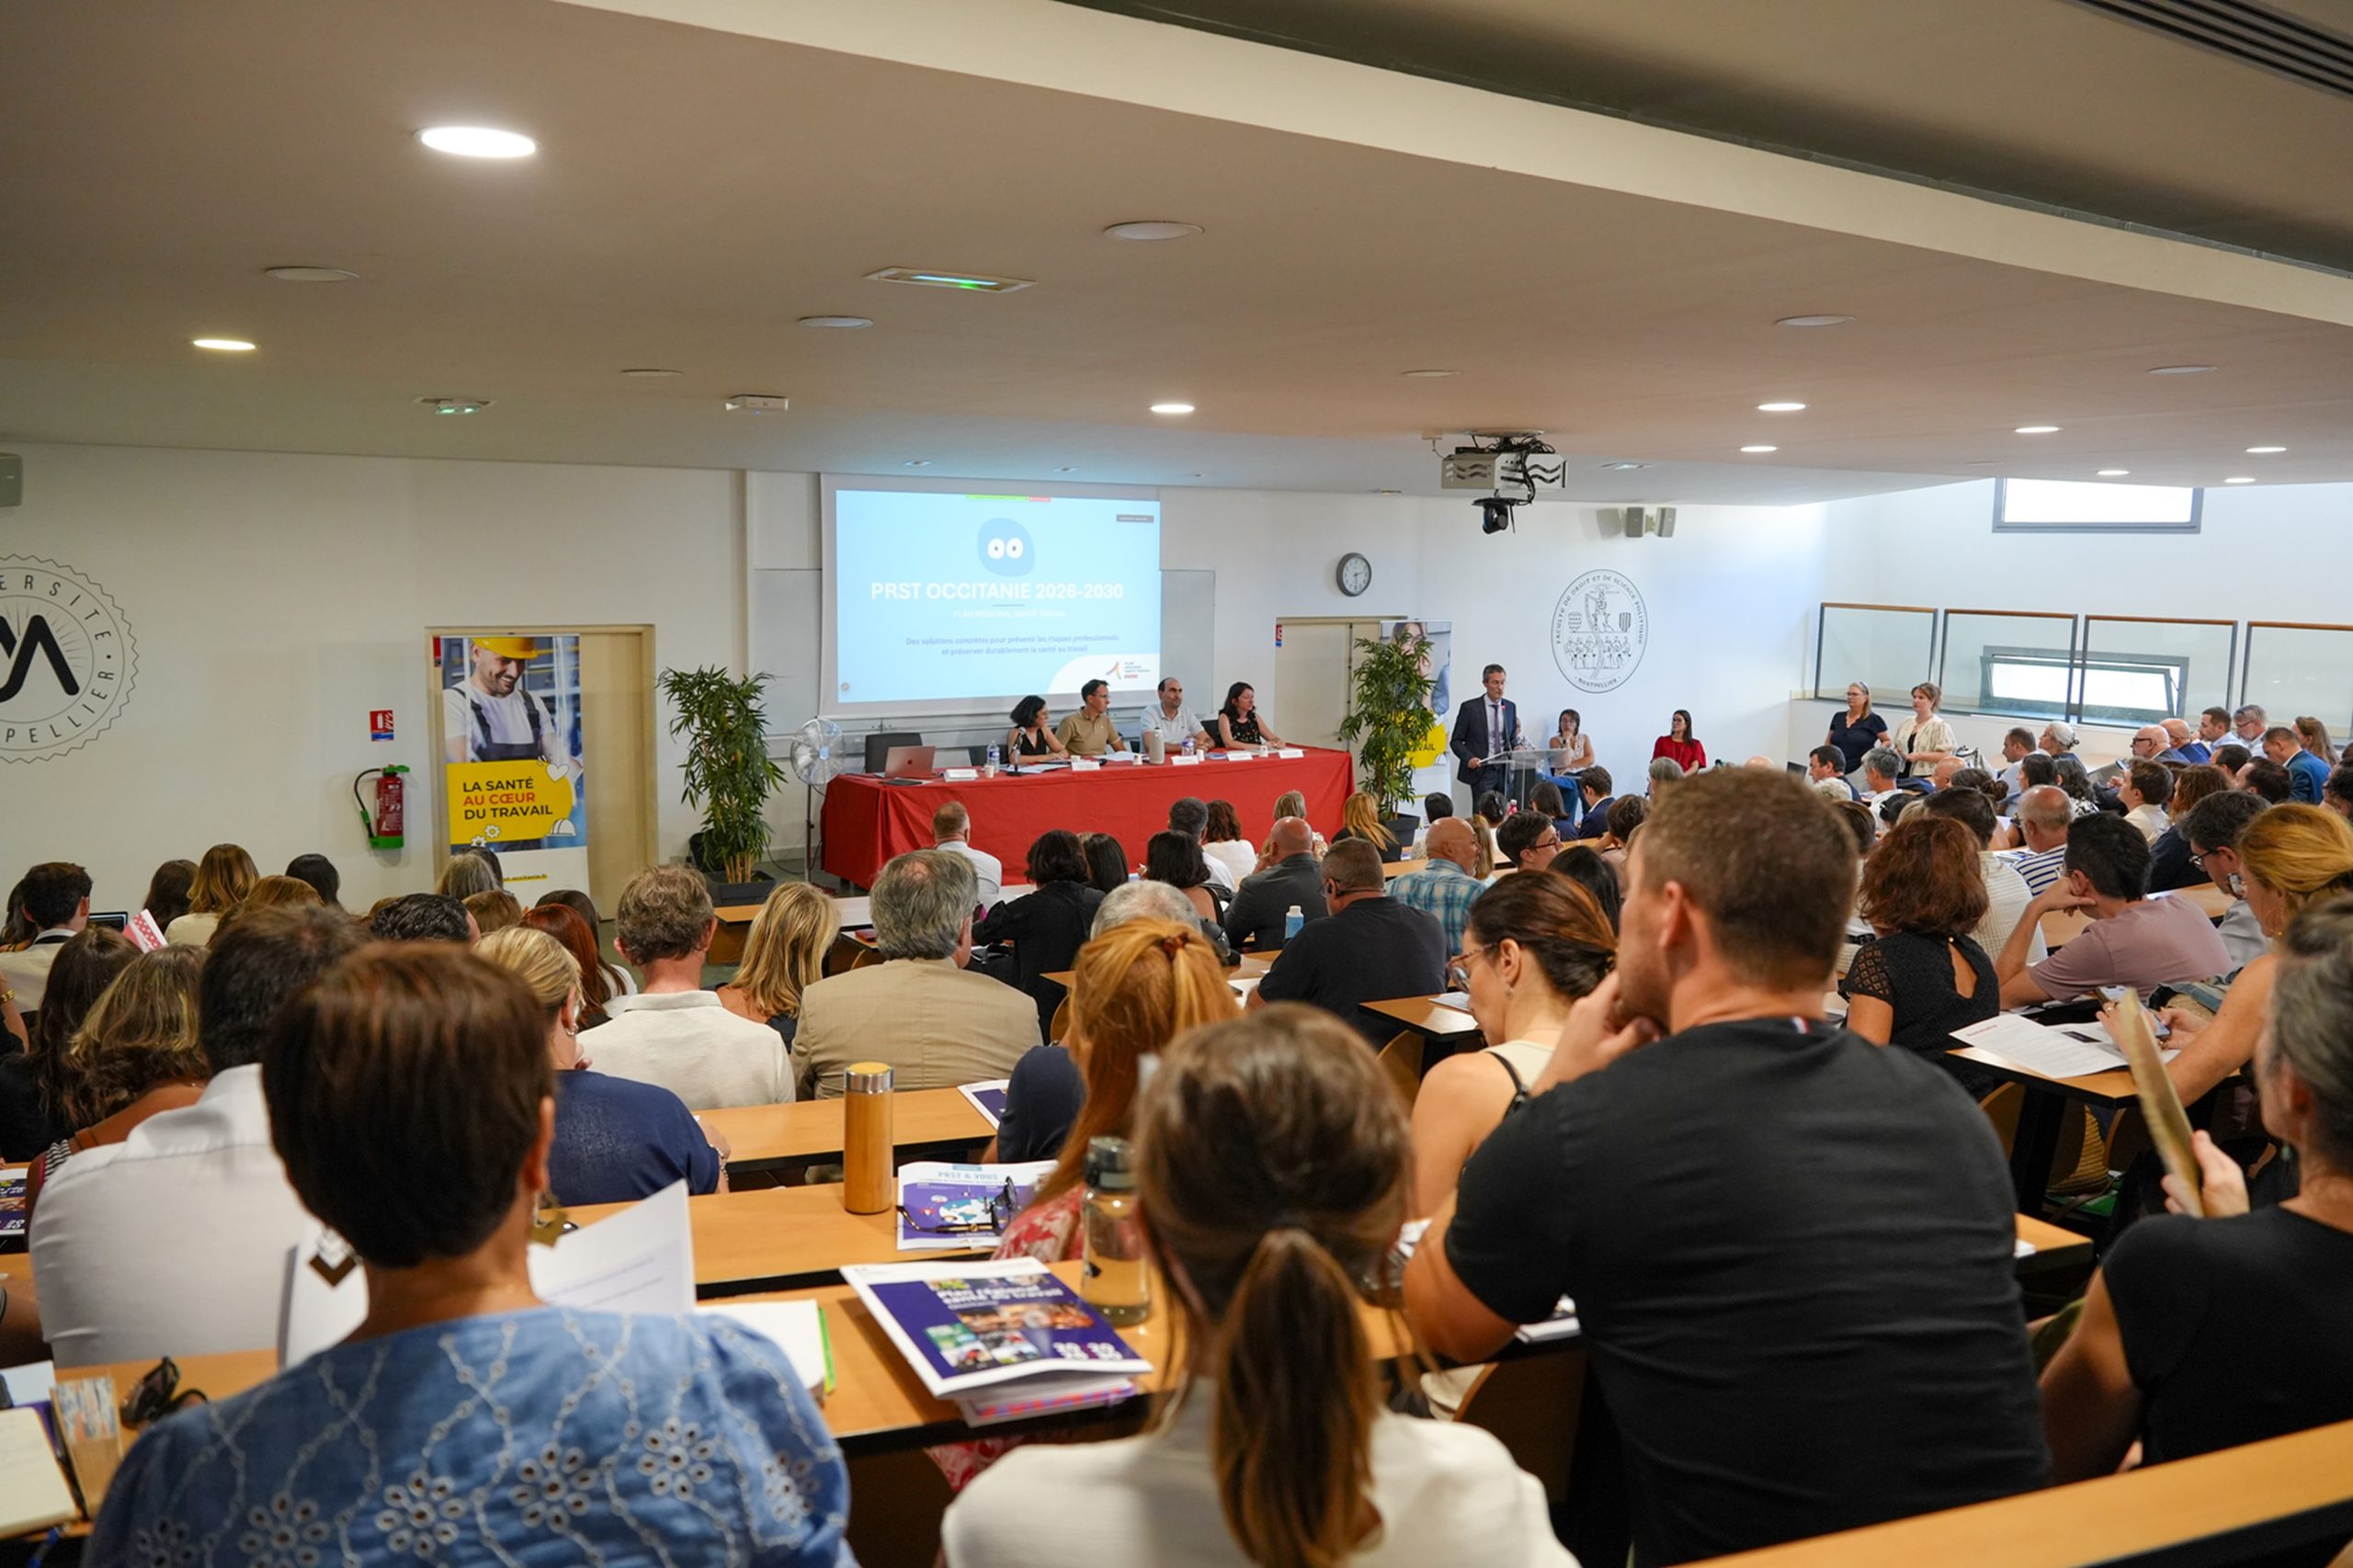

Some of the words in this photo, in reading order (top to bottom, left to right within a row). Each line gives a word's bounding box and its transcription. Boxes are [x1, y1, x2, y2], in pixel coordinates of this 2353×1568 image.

[871, 583, 922, 600] PRST
[926, 583, 1031, 599] OCCITANIE
[1036, 583, 1123, 598] 2026-2030
[1572, 578, 1590, 597] DROIT
[905, 637, 919, 645] Des
[921, 637, 953, 645] solutions
[990, 637, 1006, 646] pour
[1037, 635, 1046, 643] les
[1048, 635, 1072, 644] risques
[1577, 677, 1618, 688] MONTPELLIER
[463, 781, 483, 792] LA
[485, 776, 534, 791] SANTÉ
[463, 794, 484, 806] AU
[489, 791, 536, 805] CŒUR
[464, 809, 486, 820] DU
[490, 805, 553, 818] TRAVAIL
